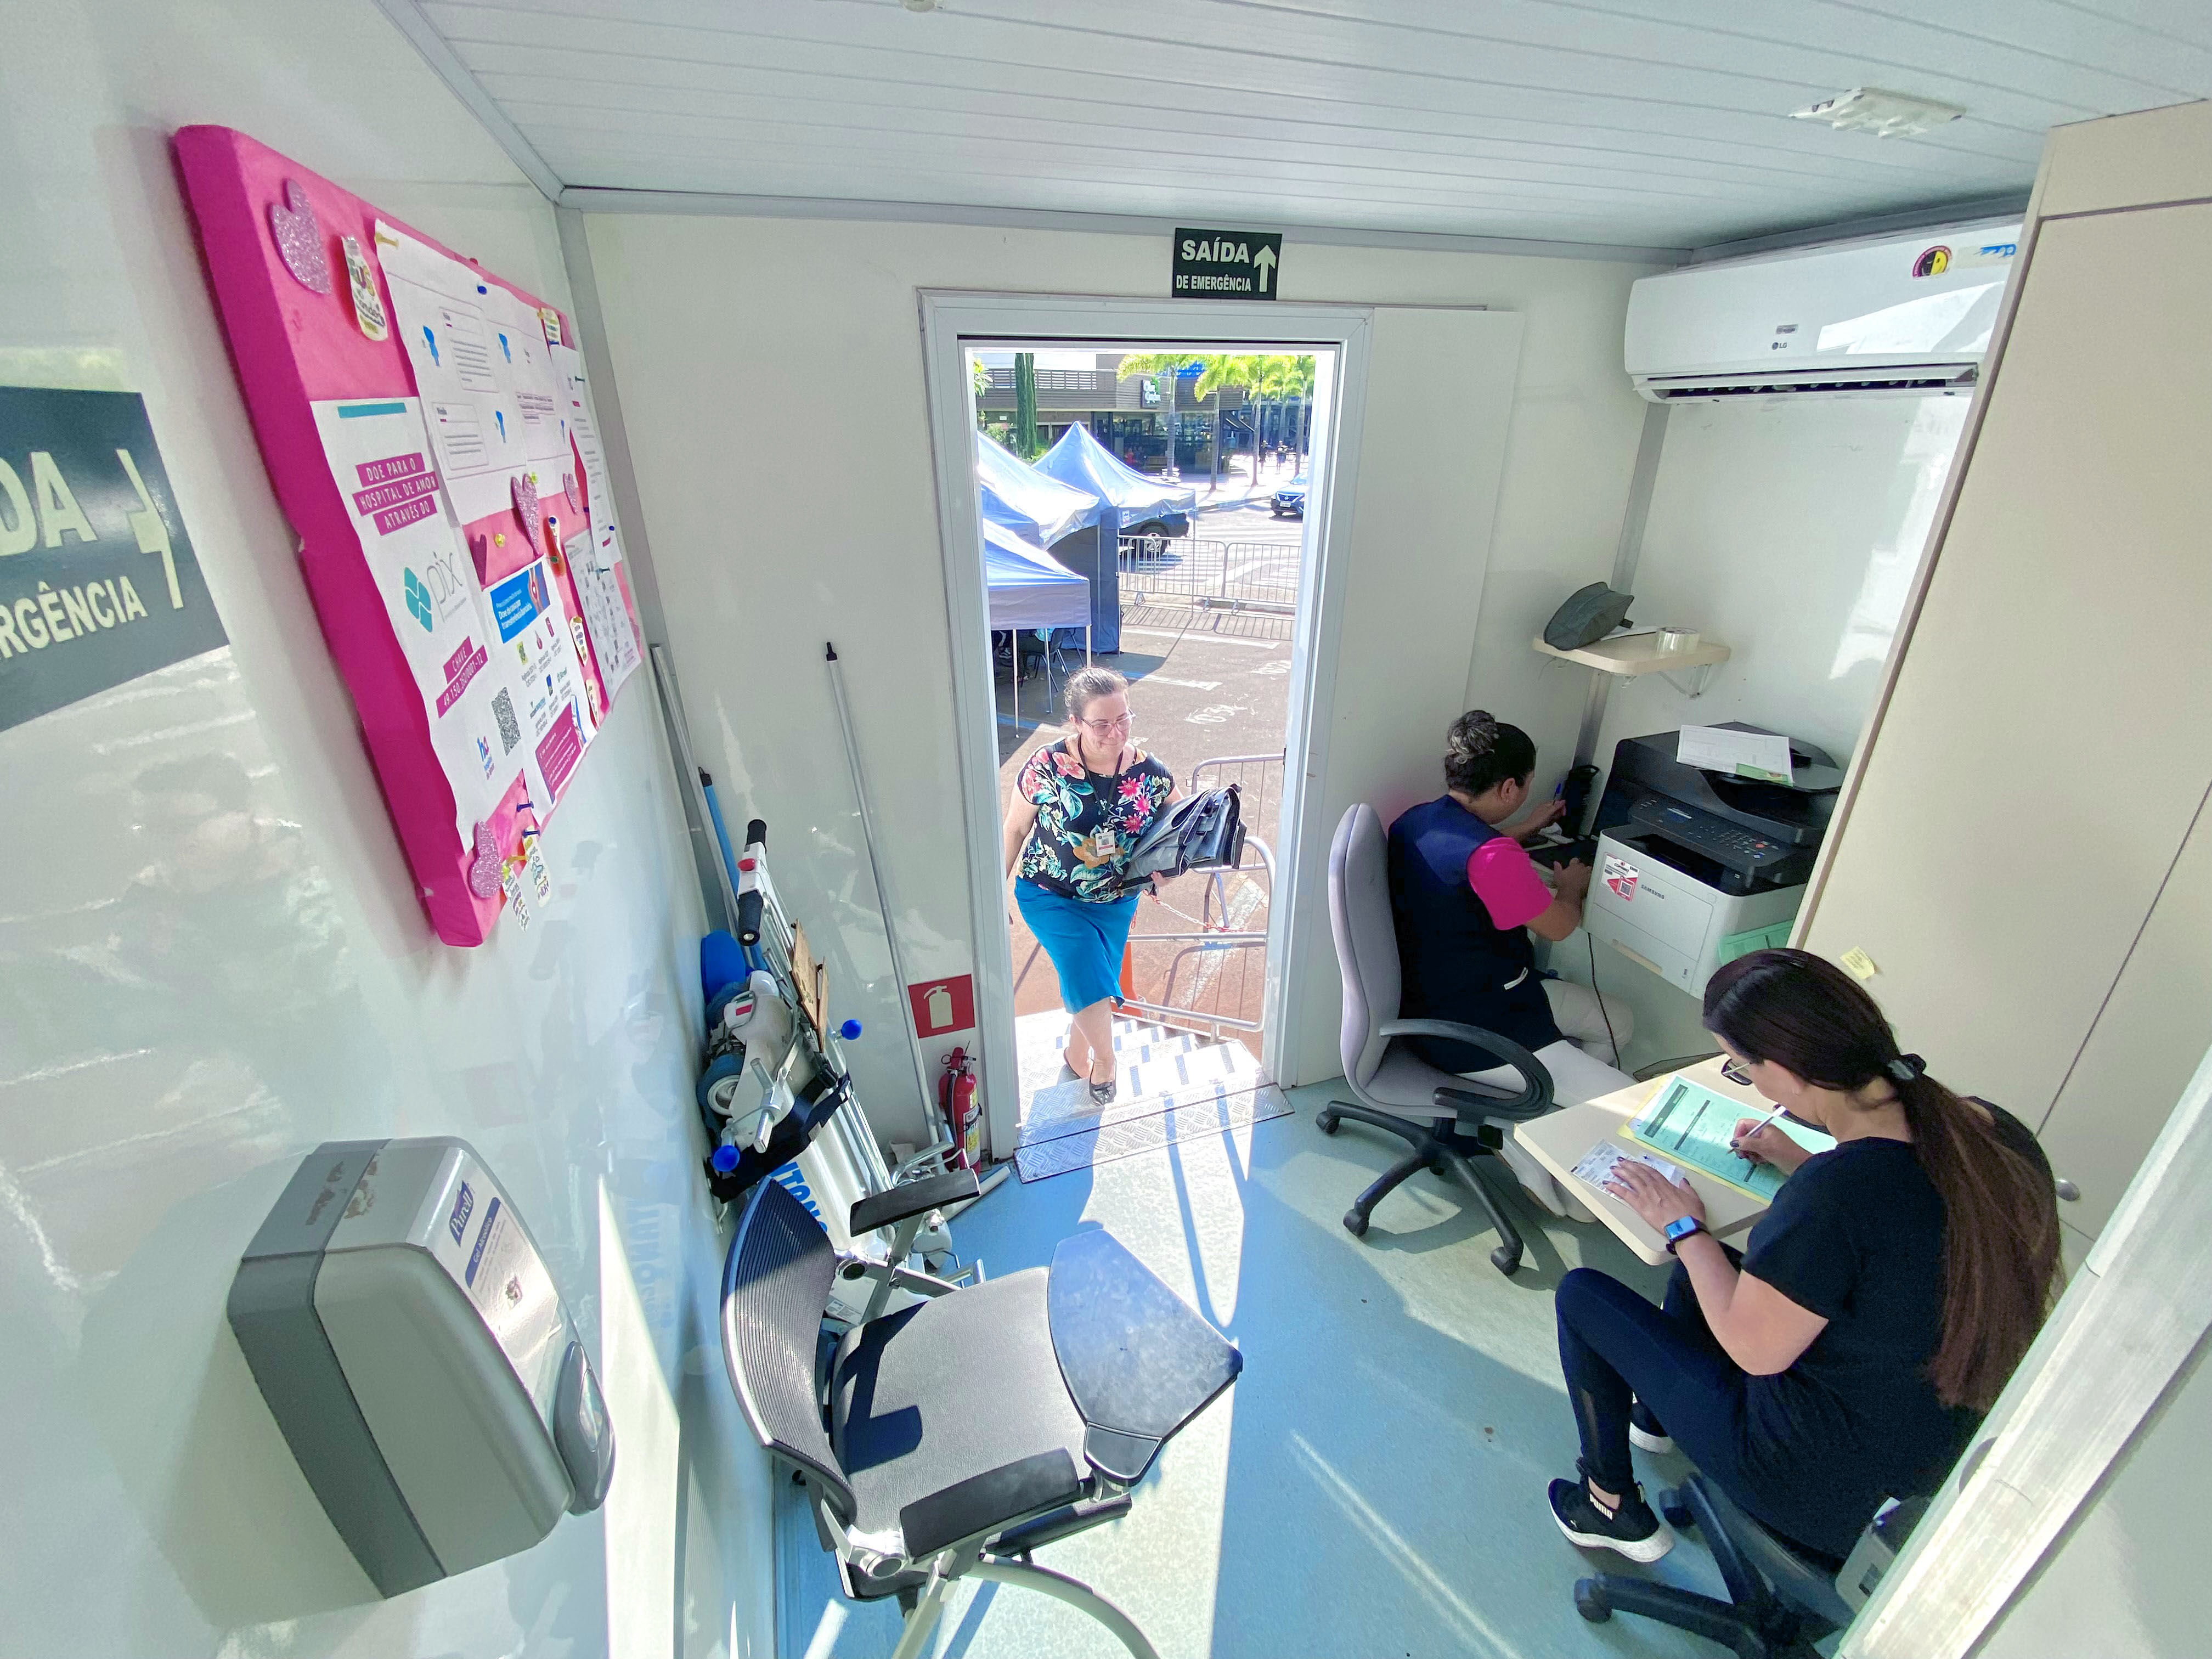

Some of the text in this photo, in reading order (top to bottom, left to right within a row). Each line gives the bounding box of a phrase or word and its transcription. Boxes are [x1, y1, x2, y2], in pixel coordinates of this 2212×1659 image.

[1181, 236, 1250, 263] SAÍDA
[1176, 274, 1251, 292] DE EMERGÊNCIA
[366, 458, 416, 481] DOE PARA O
[359, 476, 436, 510] HOSPITAL DE AMOR
[384, 500, 430, 529] ATRAVÉS DO
[1641, 884, 1664, 899] SAMSUNG
[451, 1190, 472, 1237] Purell
